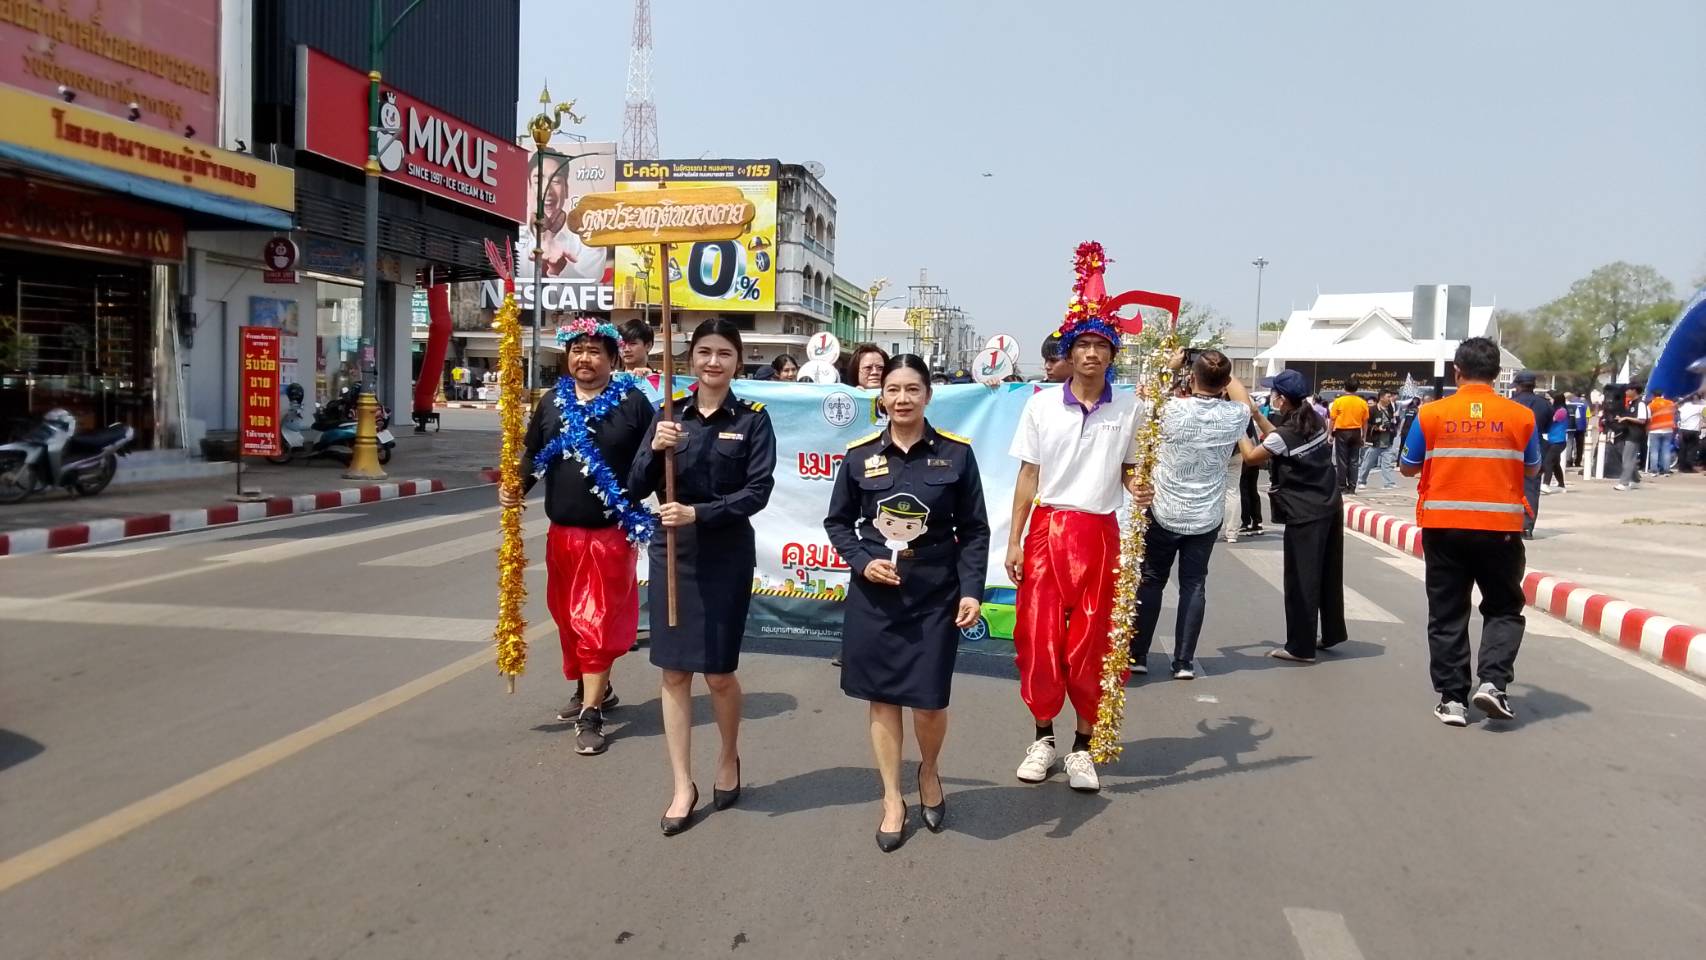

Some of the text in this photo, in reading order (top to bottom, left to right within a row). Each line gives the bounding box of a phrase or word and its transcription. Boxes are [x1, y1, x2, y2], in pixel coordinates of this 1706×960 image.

[408, 106, 498, 187] MIXUE
[623, 162, 669, 178] บี-ควิก
[746, 164, 771, 177] 1153
[408, 163, 497, 204] SINCE 1997 ICE CREAM & TEA
[245, 349, 276, 371] รับซื้อ
[250, 376, 271, 389] ขาย
[249, 392, 271, 407] ฝาก
[249, 415, 272, 428] ทอง
